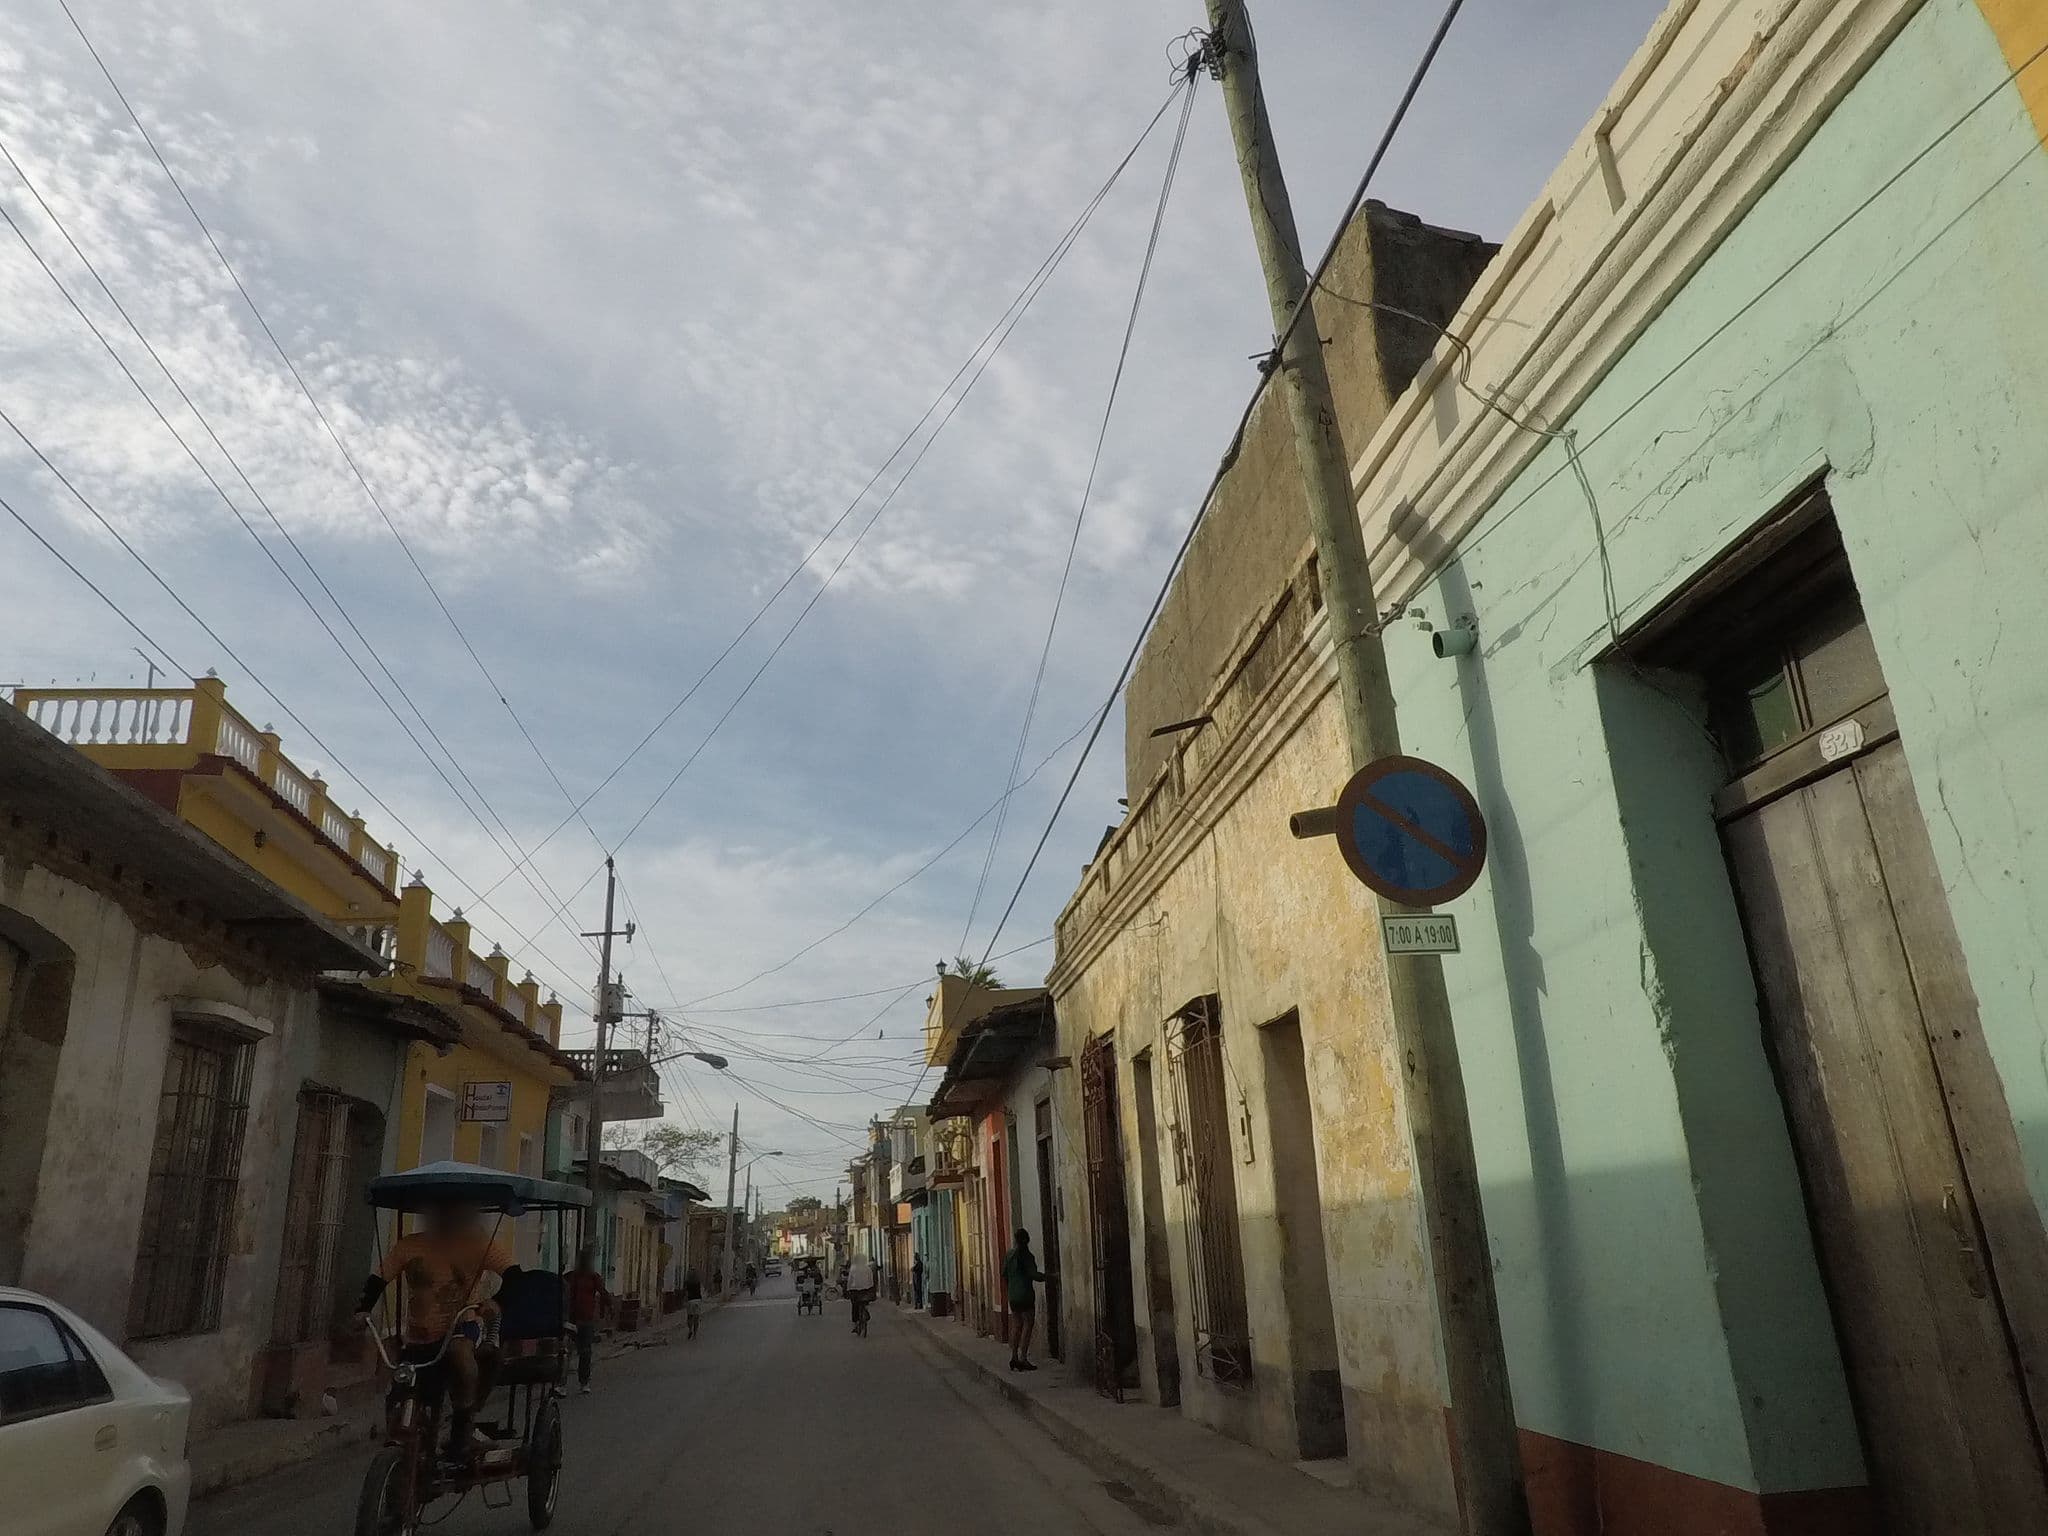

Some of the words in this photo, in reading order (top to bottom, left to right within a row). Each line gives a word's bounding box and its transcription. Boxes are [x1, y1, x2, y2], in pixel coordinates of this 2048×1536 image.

[1388, 925, 1412, 944] 7:00
[1415, 925, 1423, 944] A
[1425, 925, 1452, 943] 19:00
